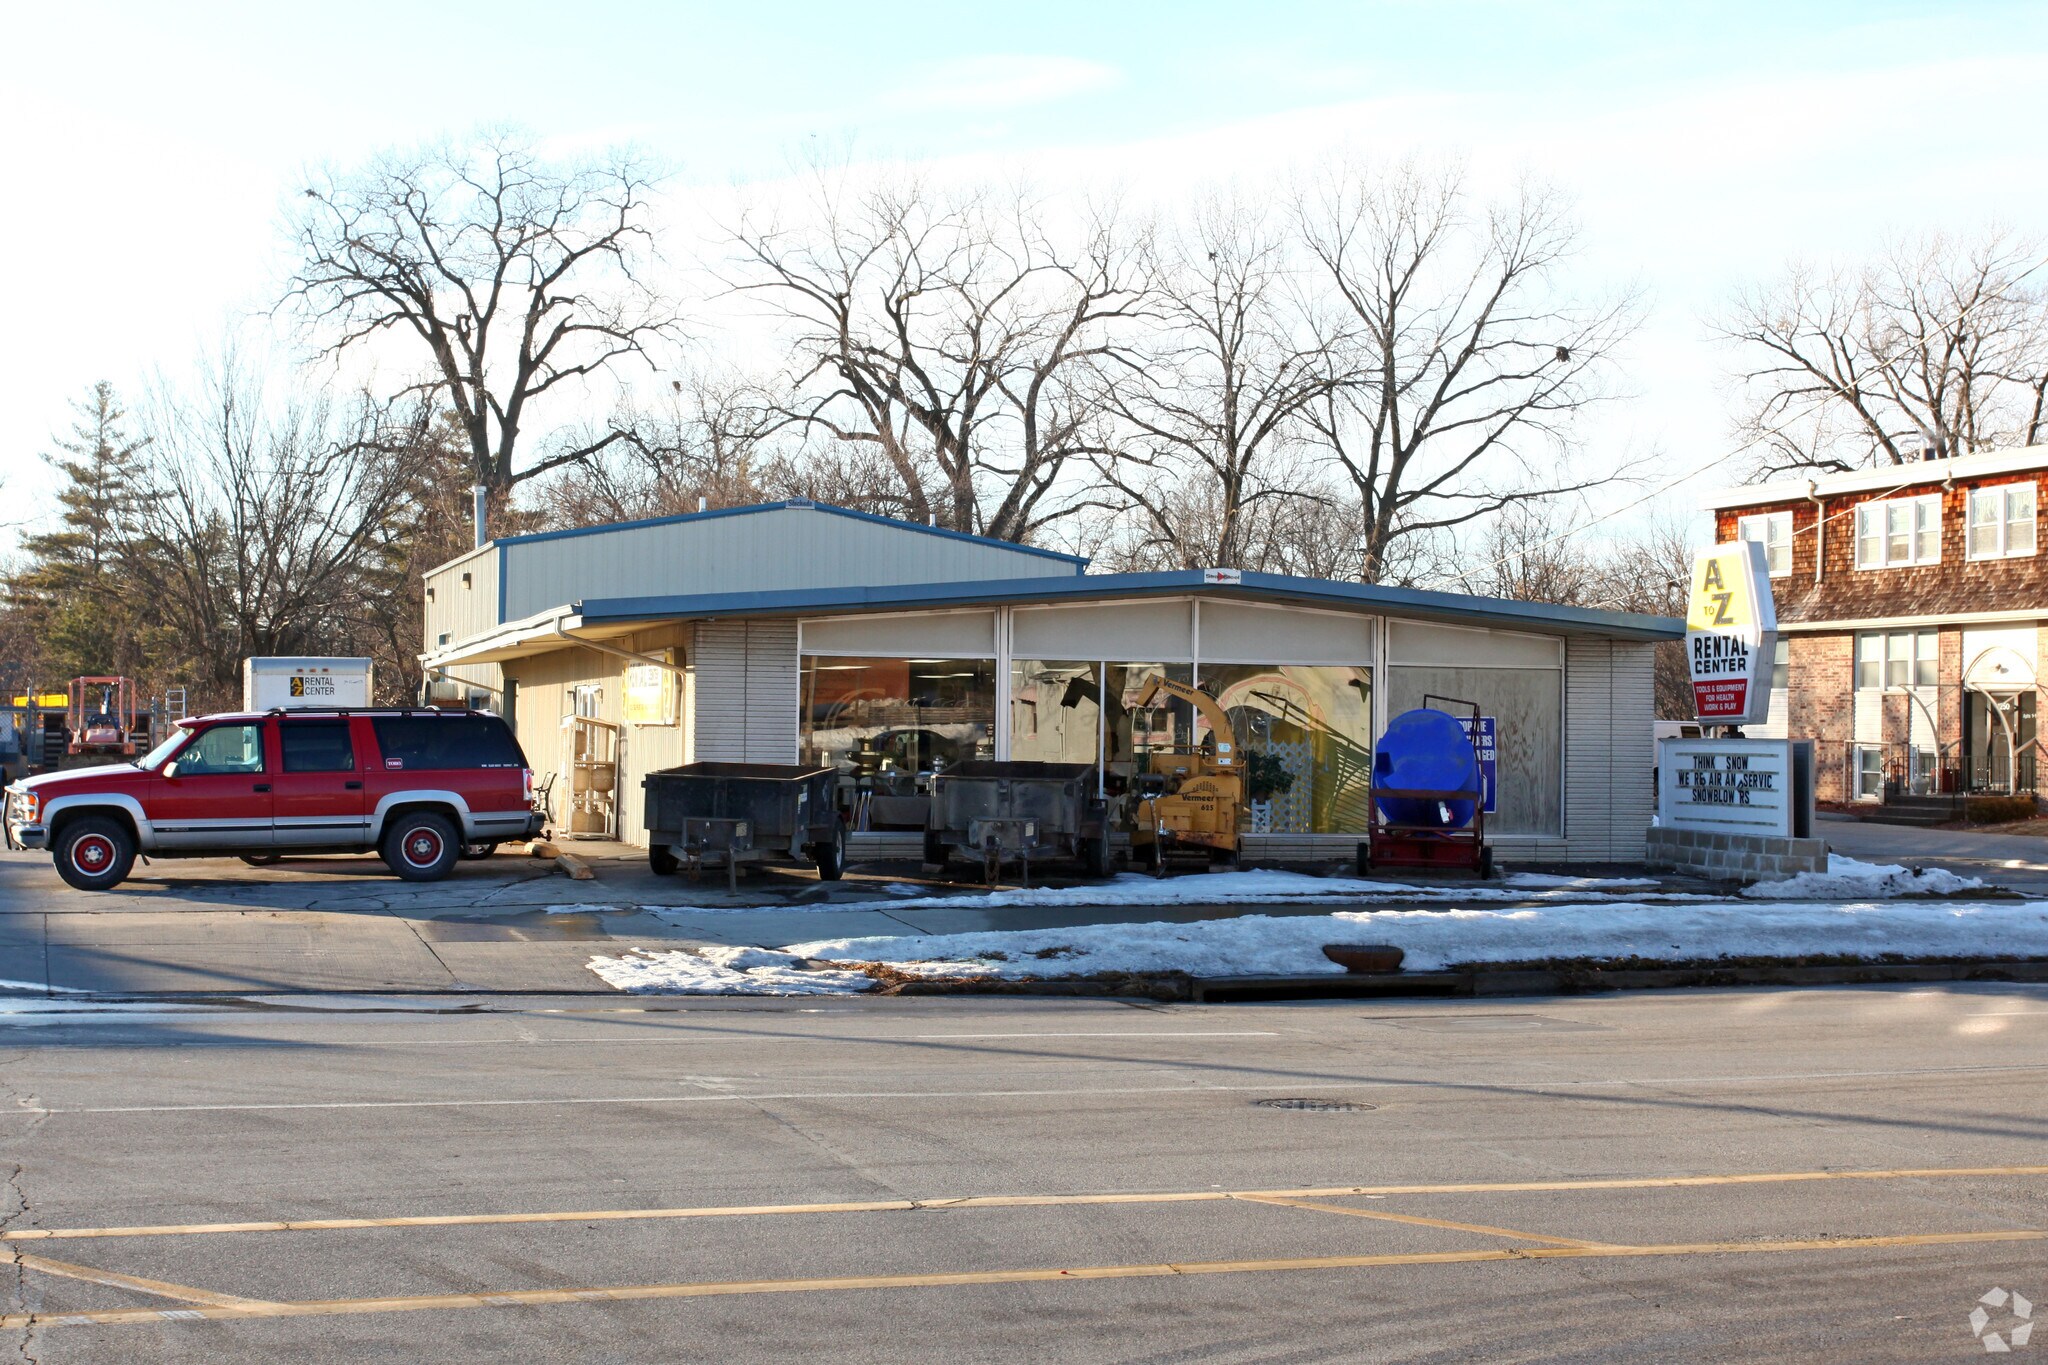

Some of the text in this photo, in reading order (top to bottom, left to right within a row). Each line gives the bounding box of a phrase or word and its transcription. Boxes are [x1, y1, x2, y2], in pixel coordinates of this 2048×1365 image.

[1703, 558, 1724, 592] A
[1703, 605, 1715, 616] TO
[1711, 592, 1734, 626] Z
[1694, 634, 1749, 659] RENTAL
[1694, 657, 1746, 674] CENTER
[304, 677, 335, 686] RENTAL
[1163, 679, 1194, 696] Vermeer
[1695, 685, 1711, 693] TOOLS
[1716, 683, 1745, 692] EQUIPMENT
[304, 686, 335, 696] CENTER
[1705, 693, 1735, 702] FOR HEALTH
[1704, 703, 1718, 711] WORK
[1724, 702, 1737, 710] PLAY
[1693, 755, 1749, 770] THINK SNOW
[1678, 771, 1690, 785] WE
[1743, 774, 1773, 788] SERVIC
[1181, 793, 1215, 801] Vermeer
